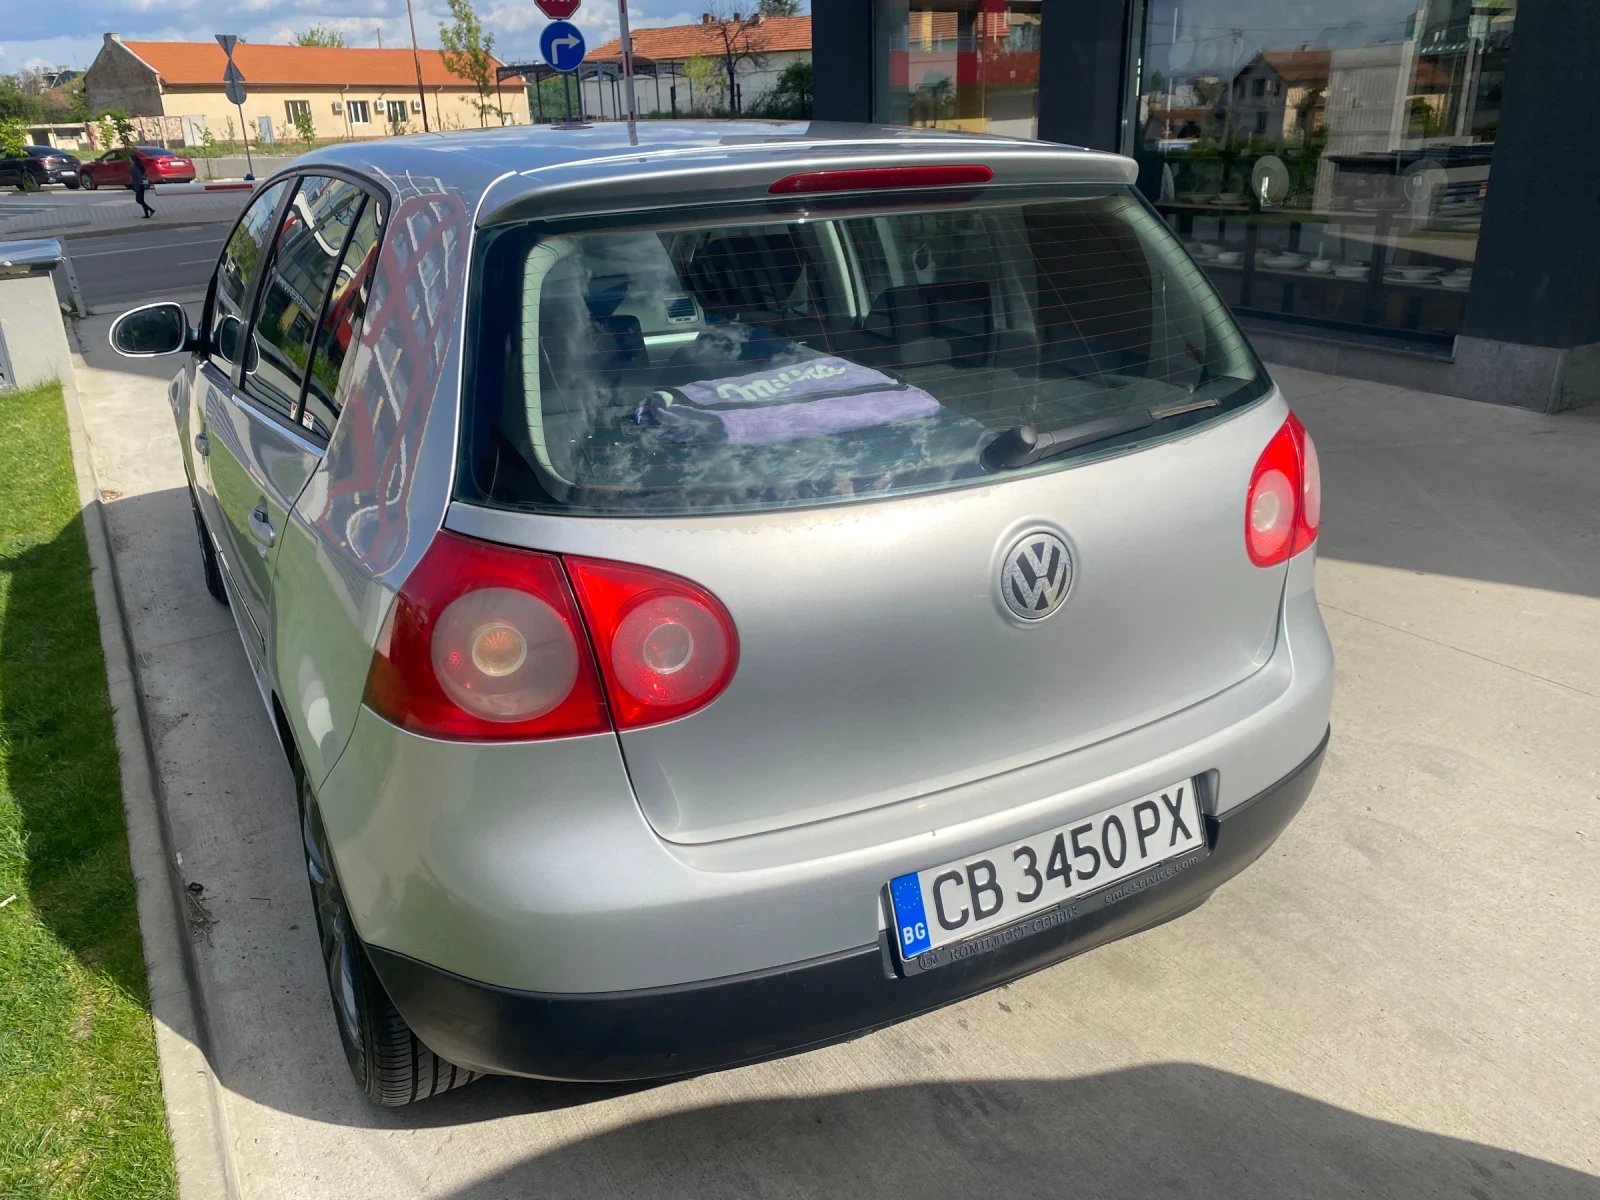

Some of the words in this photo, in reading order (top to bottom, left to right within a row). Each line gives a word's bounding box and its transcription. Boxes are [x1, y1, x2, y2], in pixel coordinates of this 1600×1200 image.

[932, 858, 1004, 931] CB
[1013, 814, 1127, 903] 3450
[1132, 787, 1193, 859] PX
[903, 922, 926, 945] BG
[949, 923, 1028, 962] КОМПЛЕКТ
